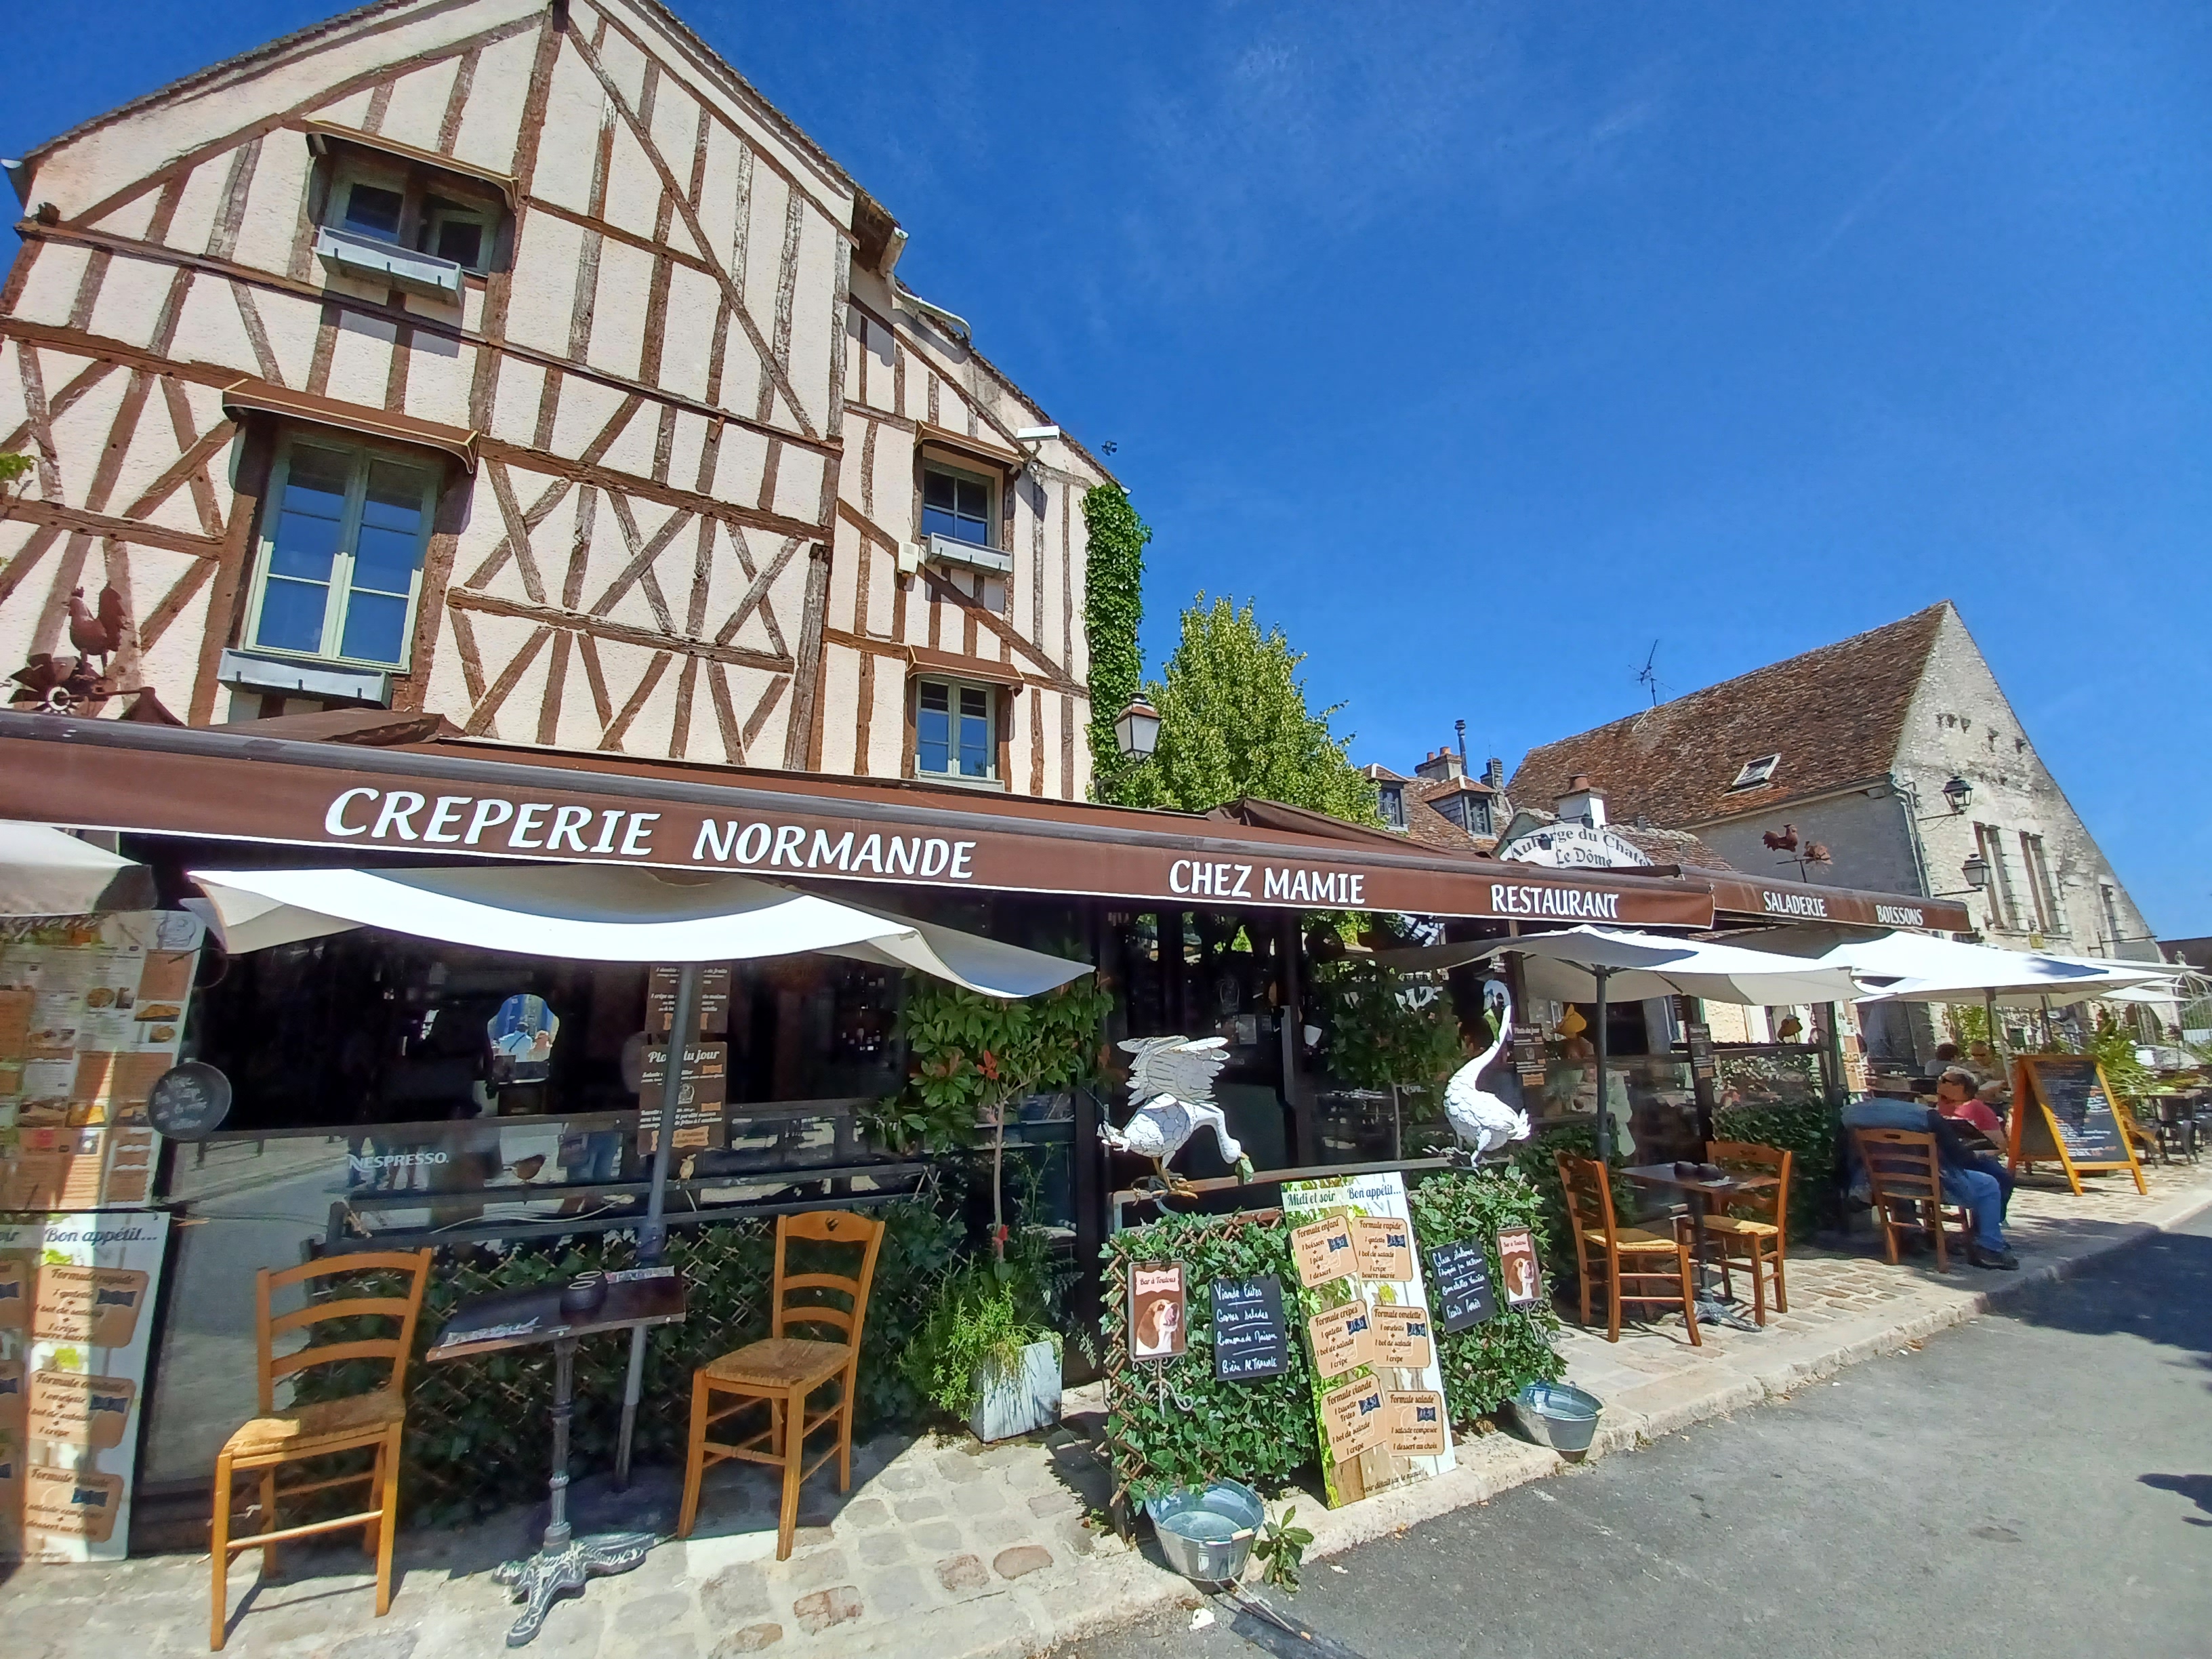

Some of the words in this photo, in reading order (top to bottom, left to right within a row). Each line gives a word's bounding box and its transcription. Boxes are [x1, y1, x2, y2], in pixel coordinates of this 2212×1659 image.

[325, 787, 662, 856] CREPERIE
[692, 819, 977, 879] NORMANDE
[1512, 829, 1574, 859] Aubrge
[1578, 828, 1598, 842] du
[1555, 848, 1572, 865] Le
[1572, 846, 1612, 867] Dôme
[1169, 859, 1252, 898] CHEZ
[1263, 867, 1366, 905] MAMIE
[1490, 884, 1620, 919] RESTAURANT
[1763, 890, 1828, 918] SALADERIE
[1875, 904, 1924, 926] BOISSONS
[694, 1050, 720, 1063] jour
[1288, 1193, 1309, 1206] Midi
[1309, 1193, 1317, 1204] et
[1319, 1191, 1336, 1202] soir
[1347, 1187, 1364, 1200] Bon
[1296, 1227, 1321, 1239] Formule
[1359, 1220, 1382, 1229] Formule
[45, 1227, 77, 1242] Bon
[1139, 1277, 1151, 1286] Bar
[1214, 1282, 1240, 1300] Viande
[1315, 1313, 1340, 1327] Formule
[1374, 1308, 1397, 1318] Formule
[1216, 1330, 1252, 1347] Limonade
[1222, 1359, 1242, 1374] Bière
[1326, 1389, 1351, 1406] Formule
[1390, 1394, 1414, 1404] Formule
